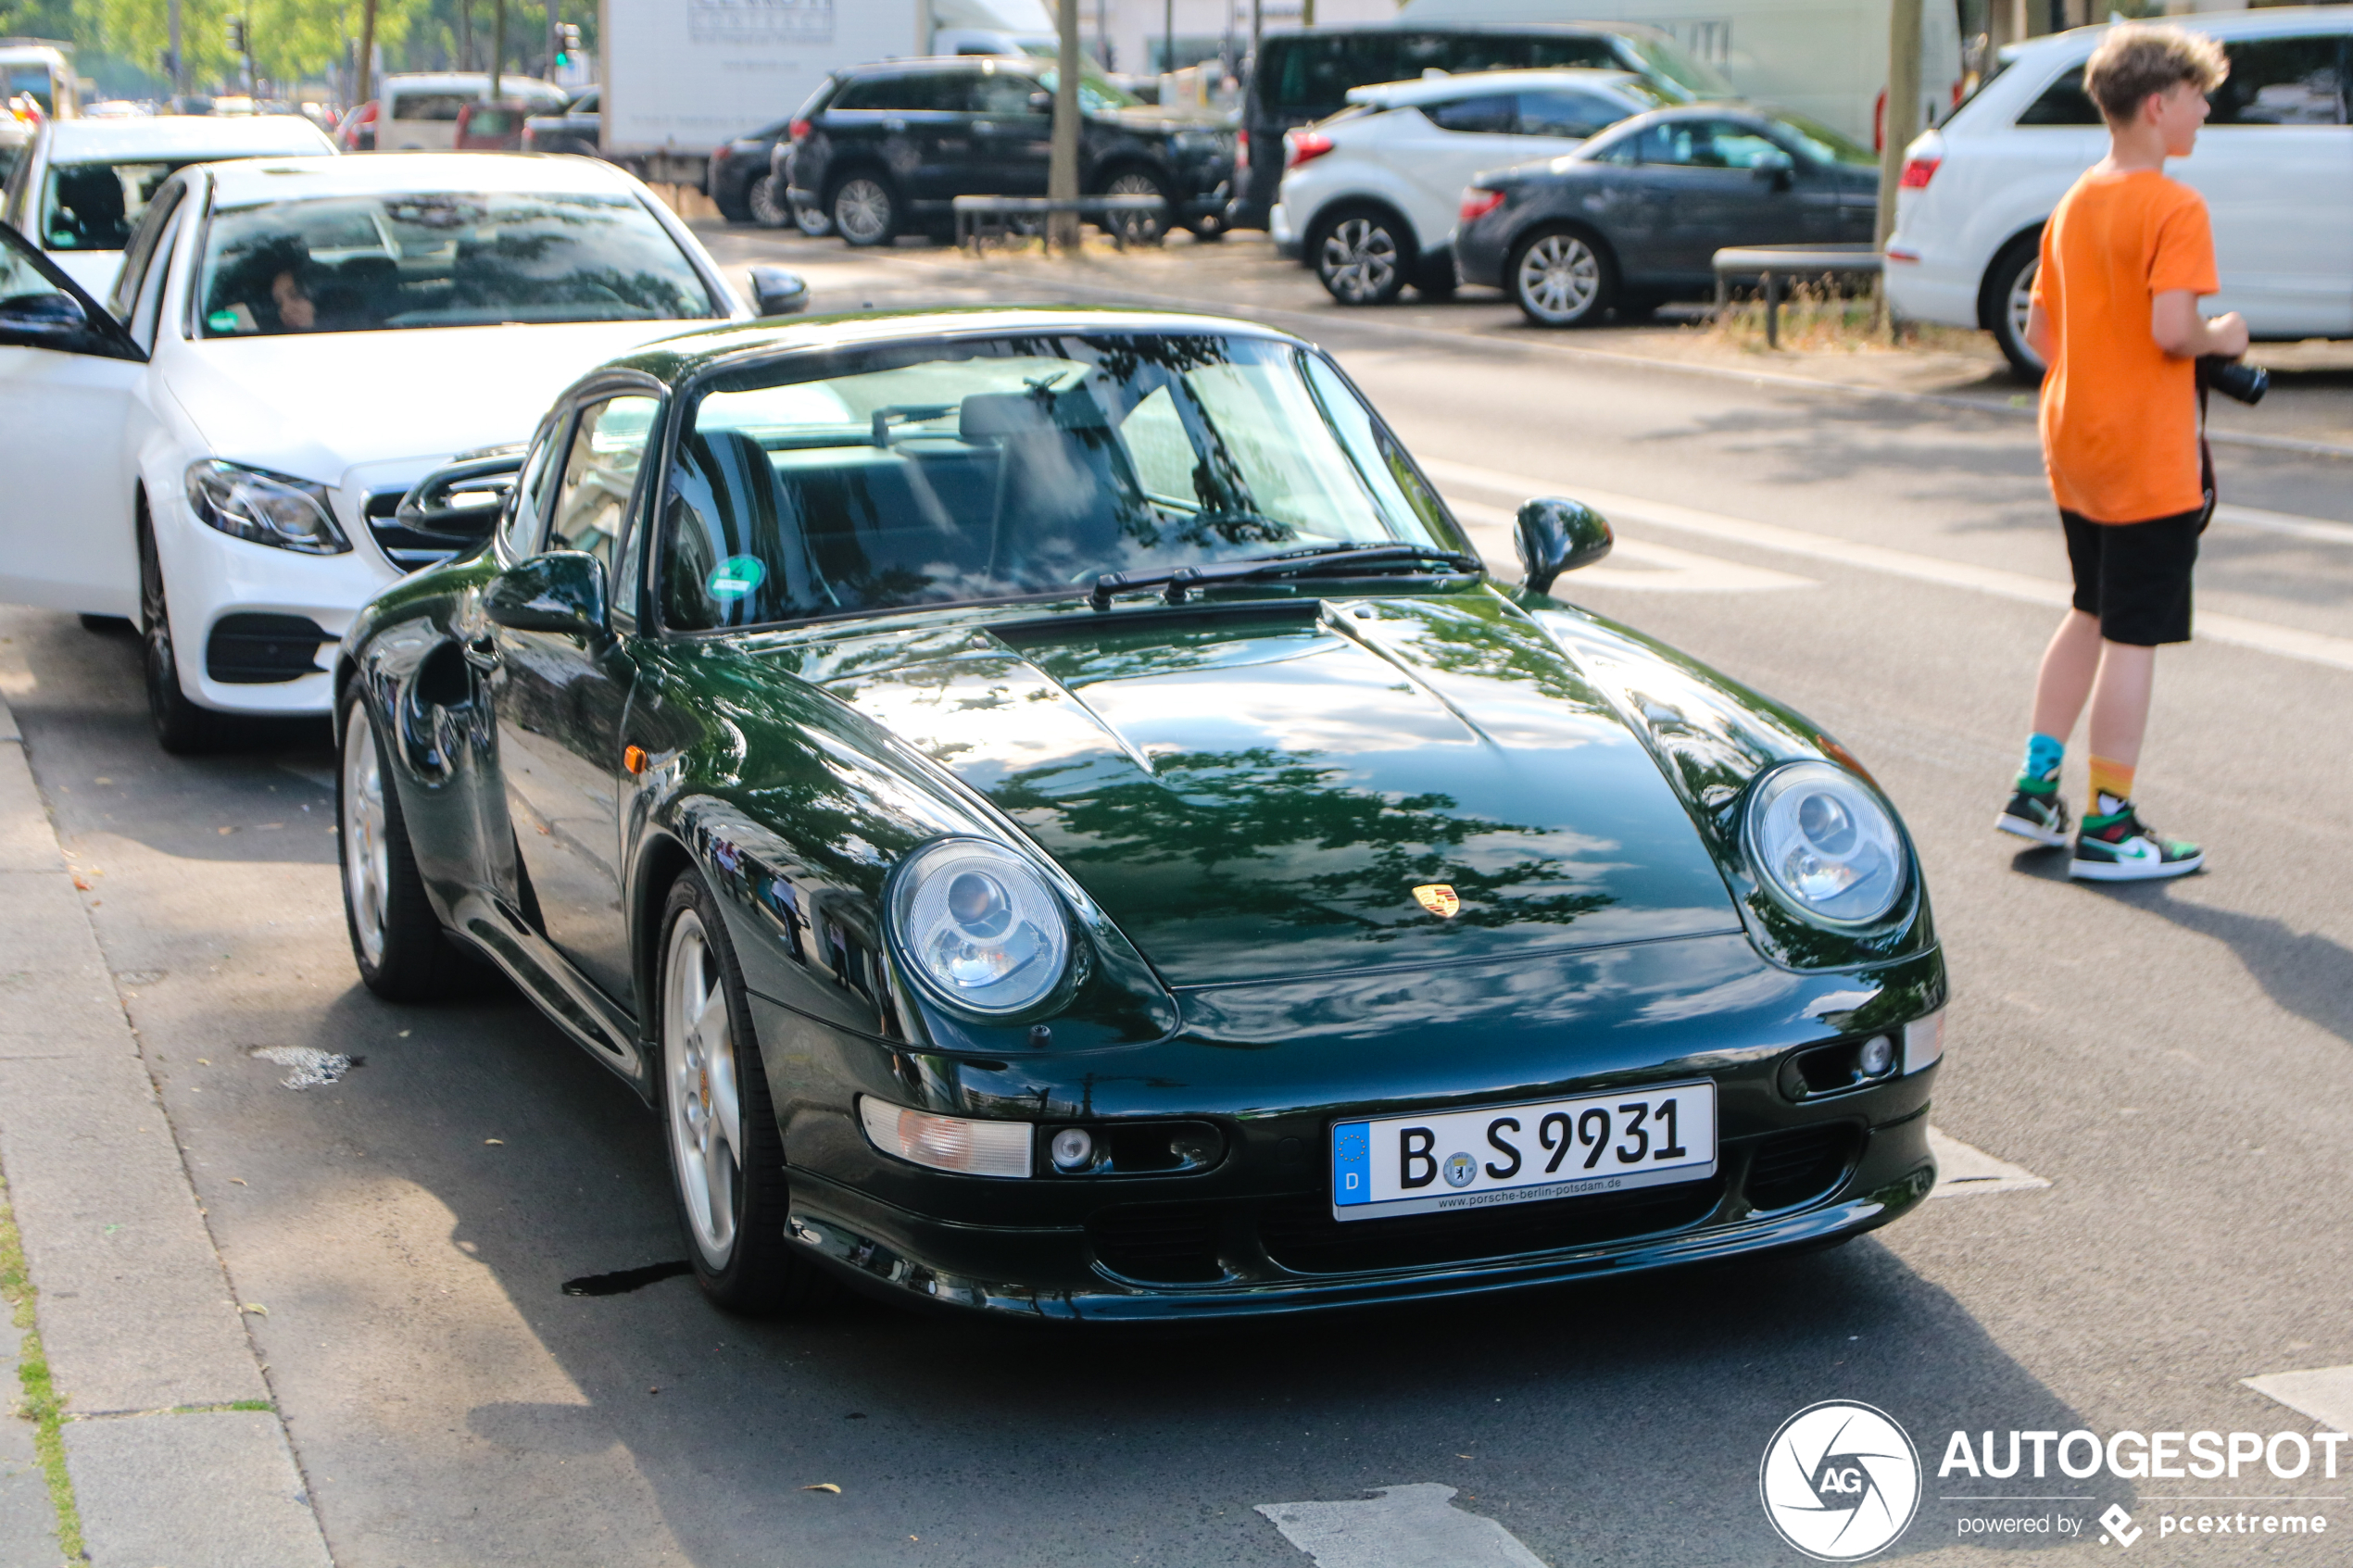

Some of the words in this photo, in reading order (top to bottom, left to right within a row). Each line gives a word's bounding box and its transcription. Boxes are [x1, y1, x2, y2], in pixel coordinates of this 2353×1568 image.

[1401, 1127, 1438, 1189] B
[1486, 1117, 1522, 1179] S
[1539, 1098, 1686, 1173] 9931
[1345, 1173, 1359, 1190] D
[1439, 1178, 1621, 1208] www.porsche-berlin-potsdam.de
